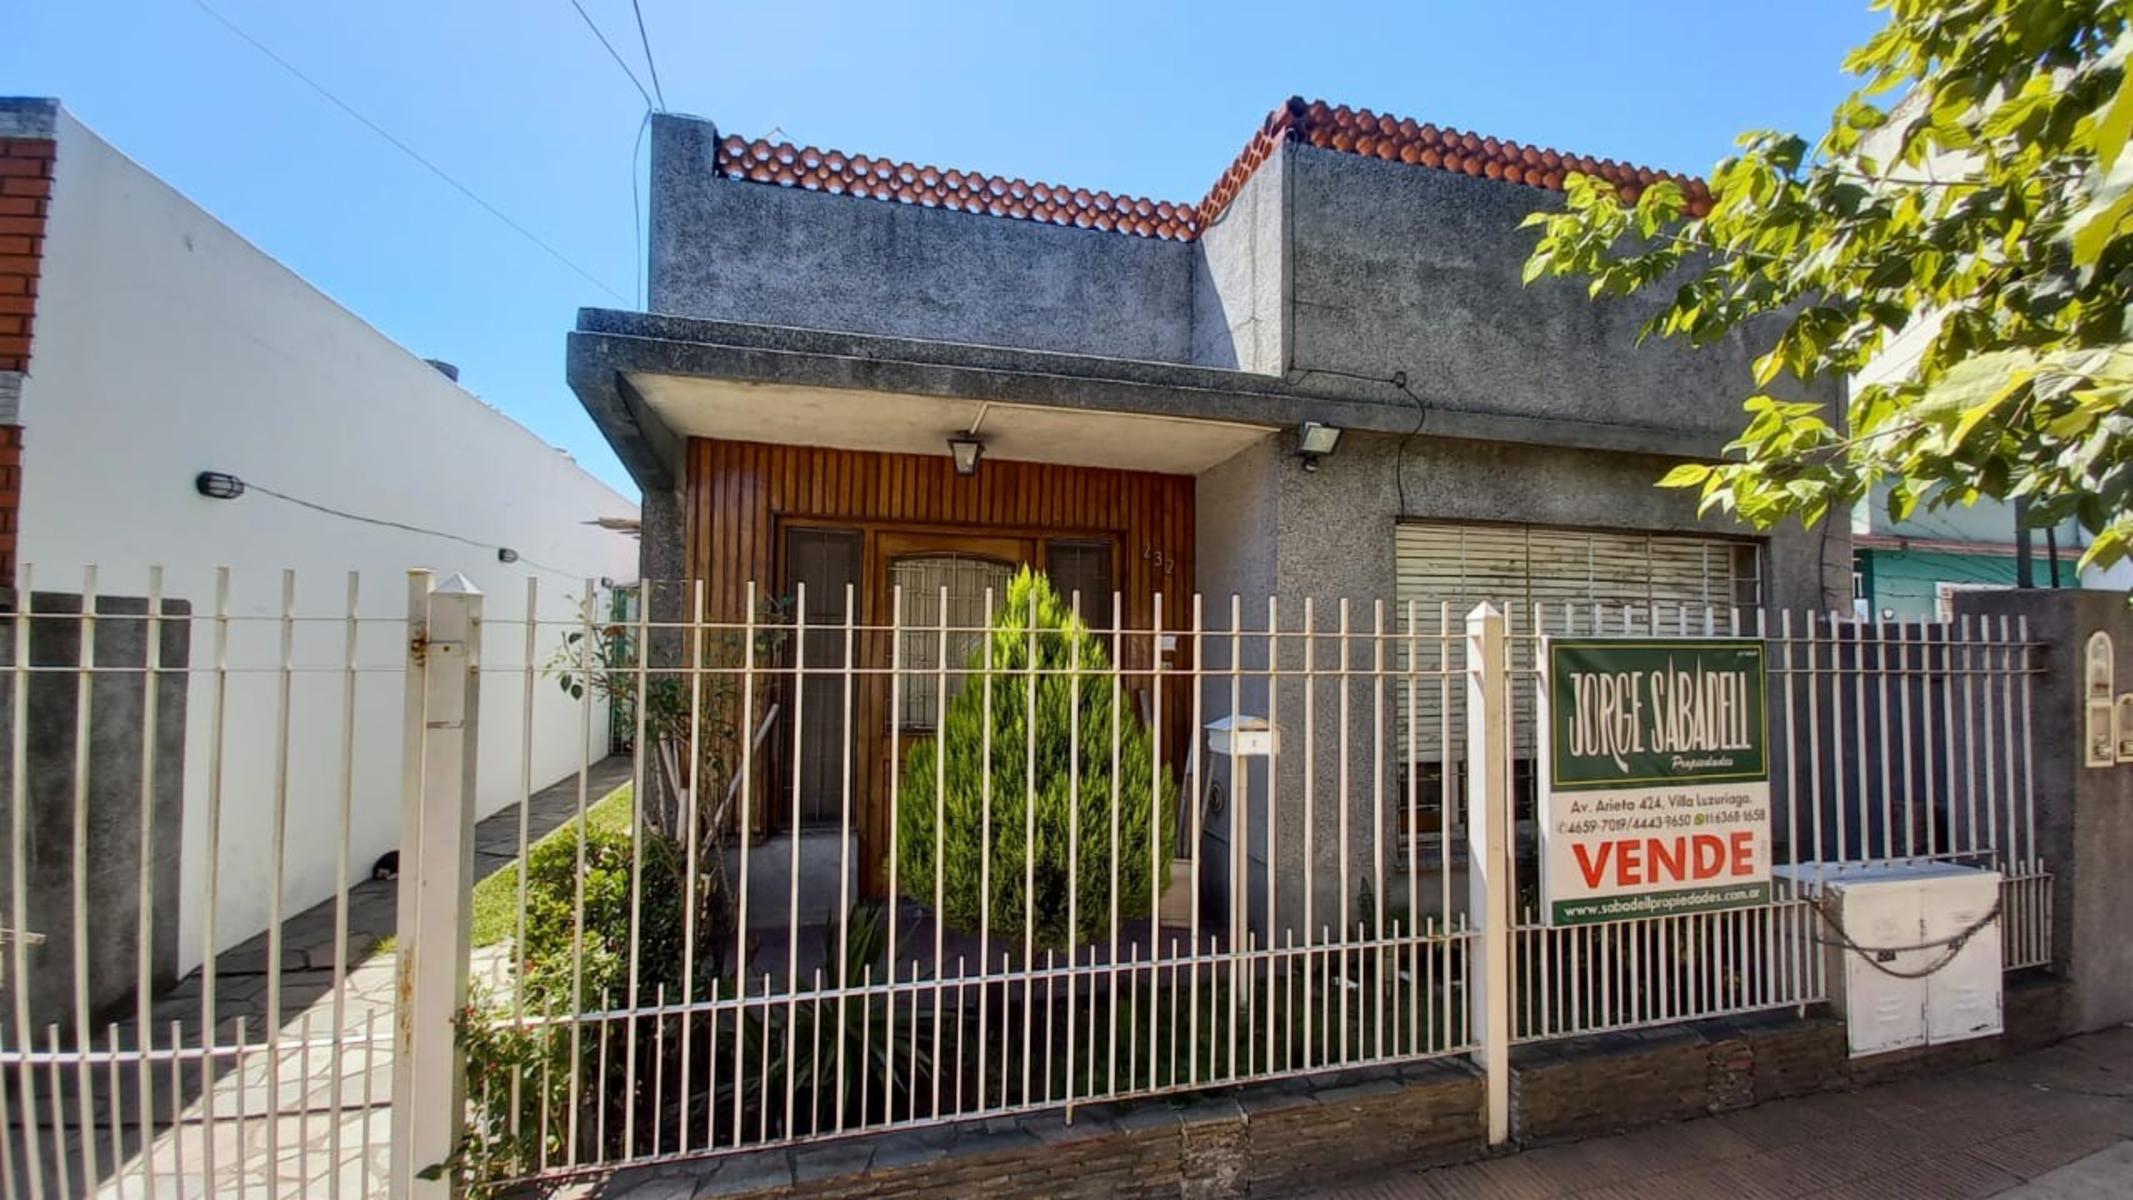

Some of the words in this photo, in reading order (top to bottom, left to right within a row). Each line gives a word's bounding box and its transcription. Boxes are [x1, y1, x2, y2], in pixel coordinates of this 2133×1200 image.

[1568, 671, 1645, 774] JORGE
[1650, 652, 1752, 754] SABADELL
[1570, 799, 1593, 814] Av.
[1668, 793, 1694, 808] Villa
[1572, 831, 1753, 890] VENDE
[1564, 887, 1761, 917] www.sabadellpropiedades.com.ar
